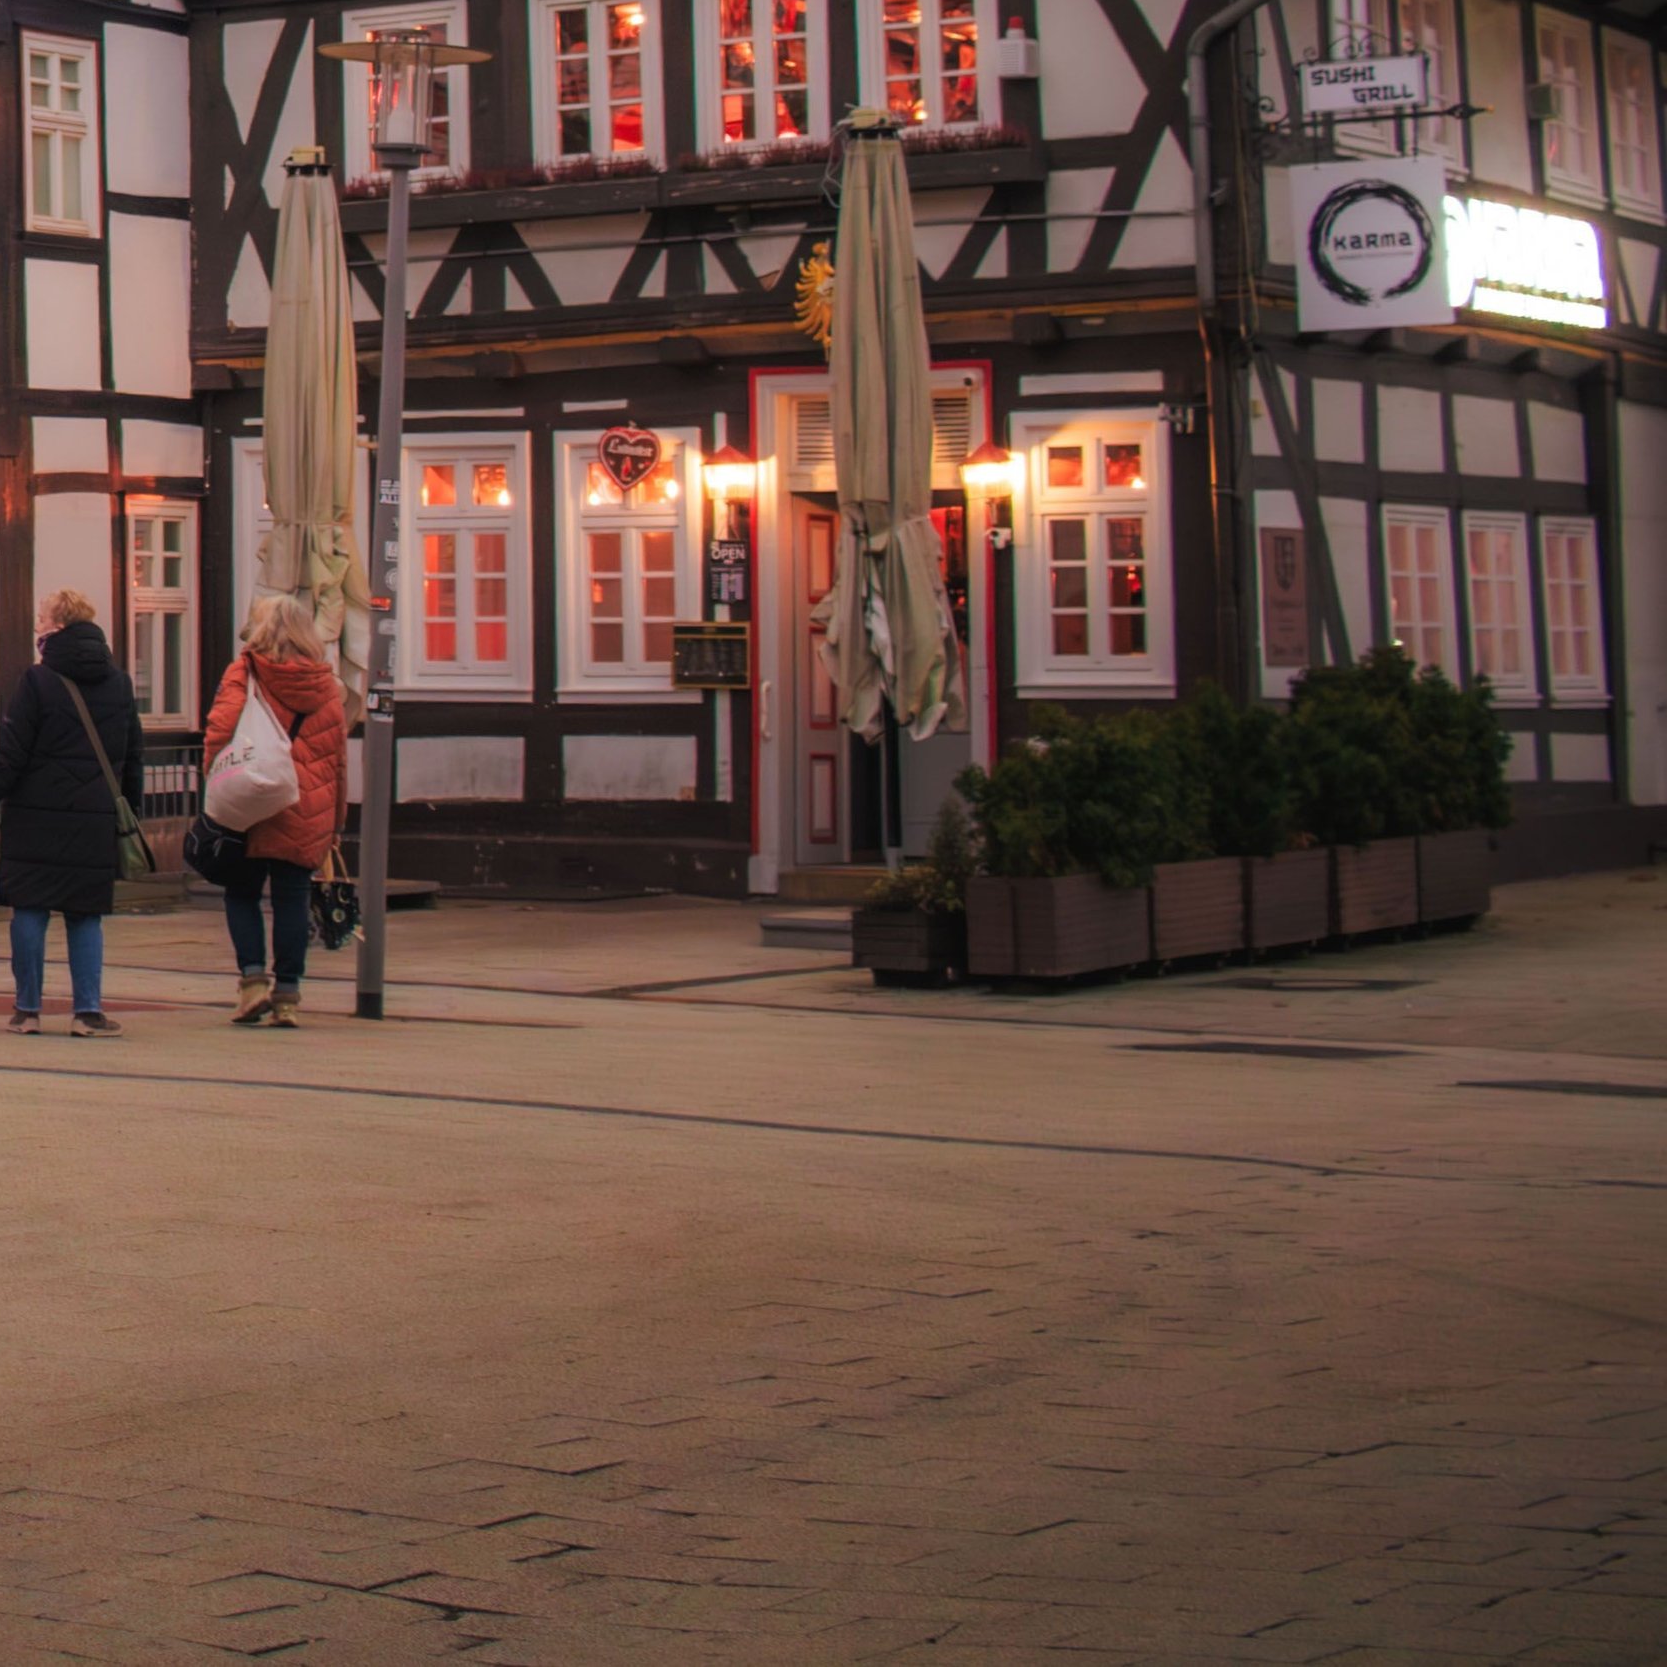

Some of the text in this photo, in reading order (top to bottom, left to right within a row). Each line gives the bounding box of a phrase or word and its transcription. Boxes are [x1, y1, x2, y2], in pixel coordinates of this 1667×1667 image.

[1311, 65, 1375, 86] SUSHI
[1352, 84, 1415, 103] GRILL
[711, 549, 746, 560] OPEN
